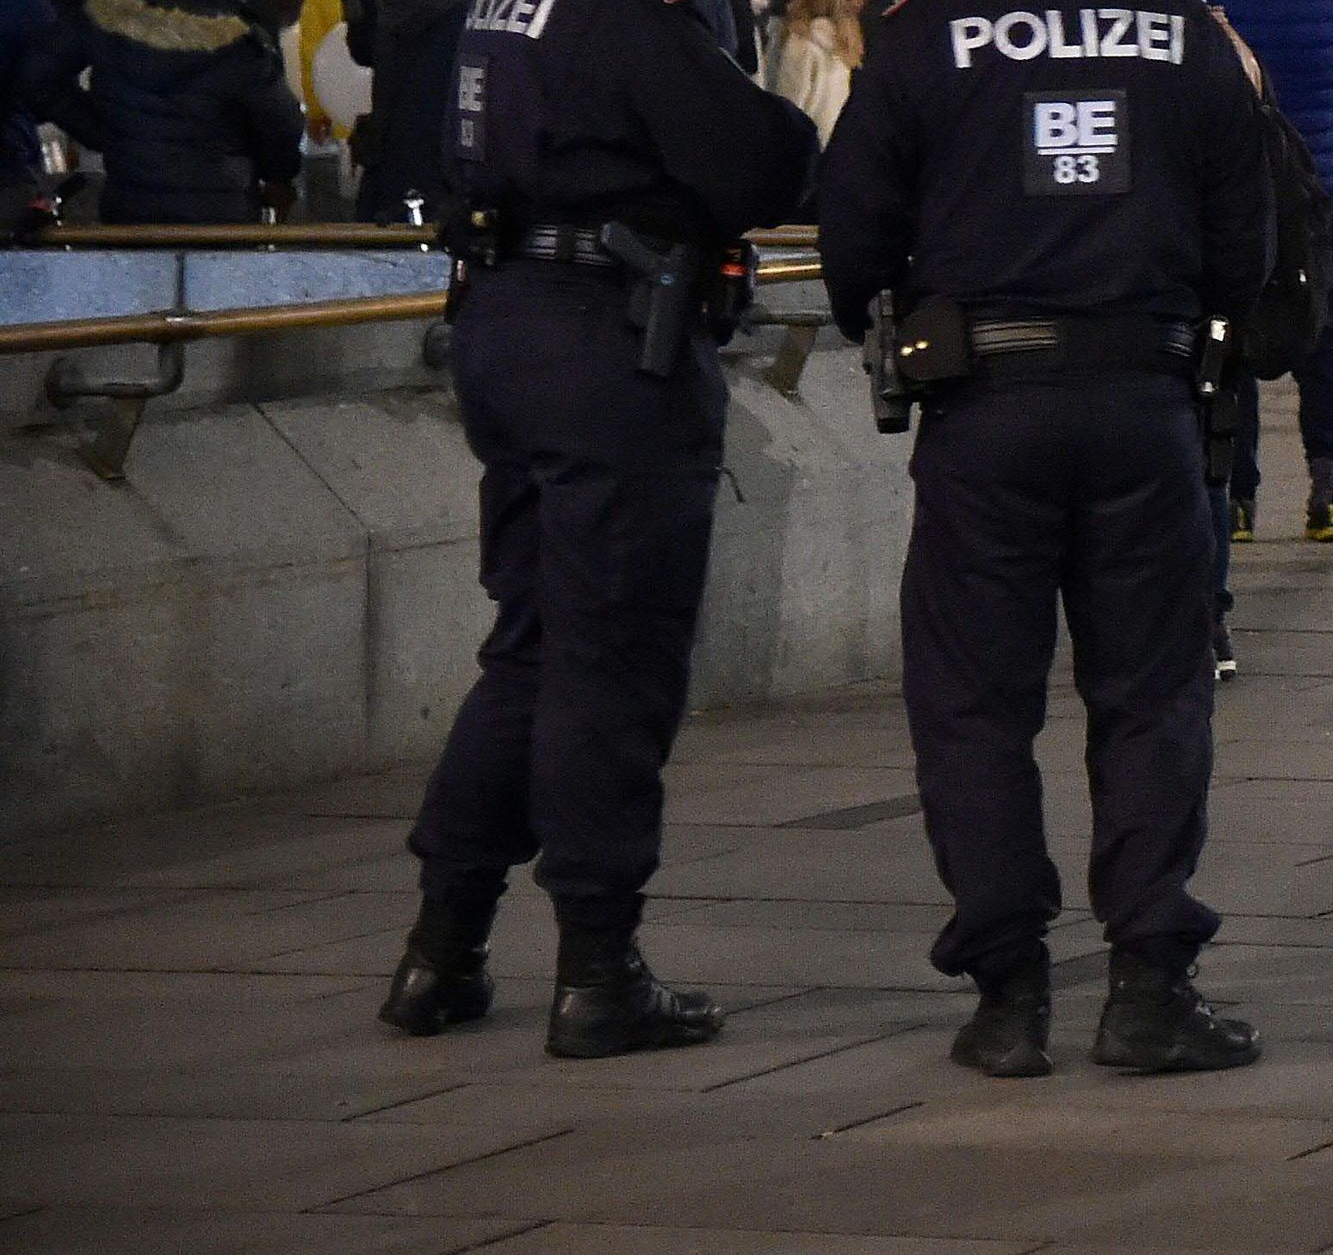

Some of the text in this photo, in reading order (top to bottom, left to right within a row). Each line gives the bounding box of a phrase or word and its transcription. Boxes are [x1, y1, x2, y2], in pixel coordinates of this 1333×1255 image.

[950, 9, 1185, 69] POLIZEI
[1034, 100, 1119, 147] BE
[1053, 154, 1100, 184] 83
